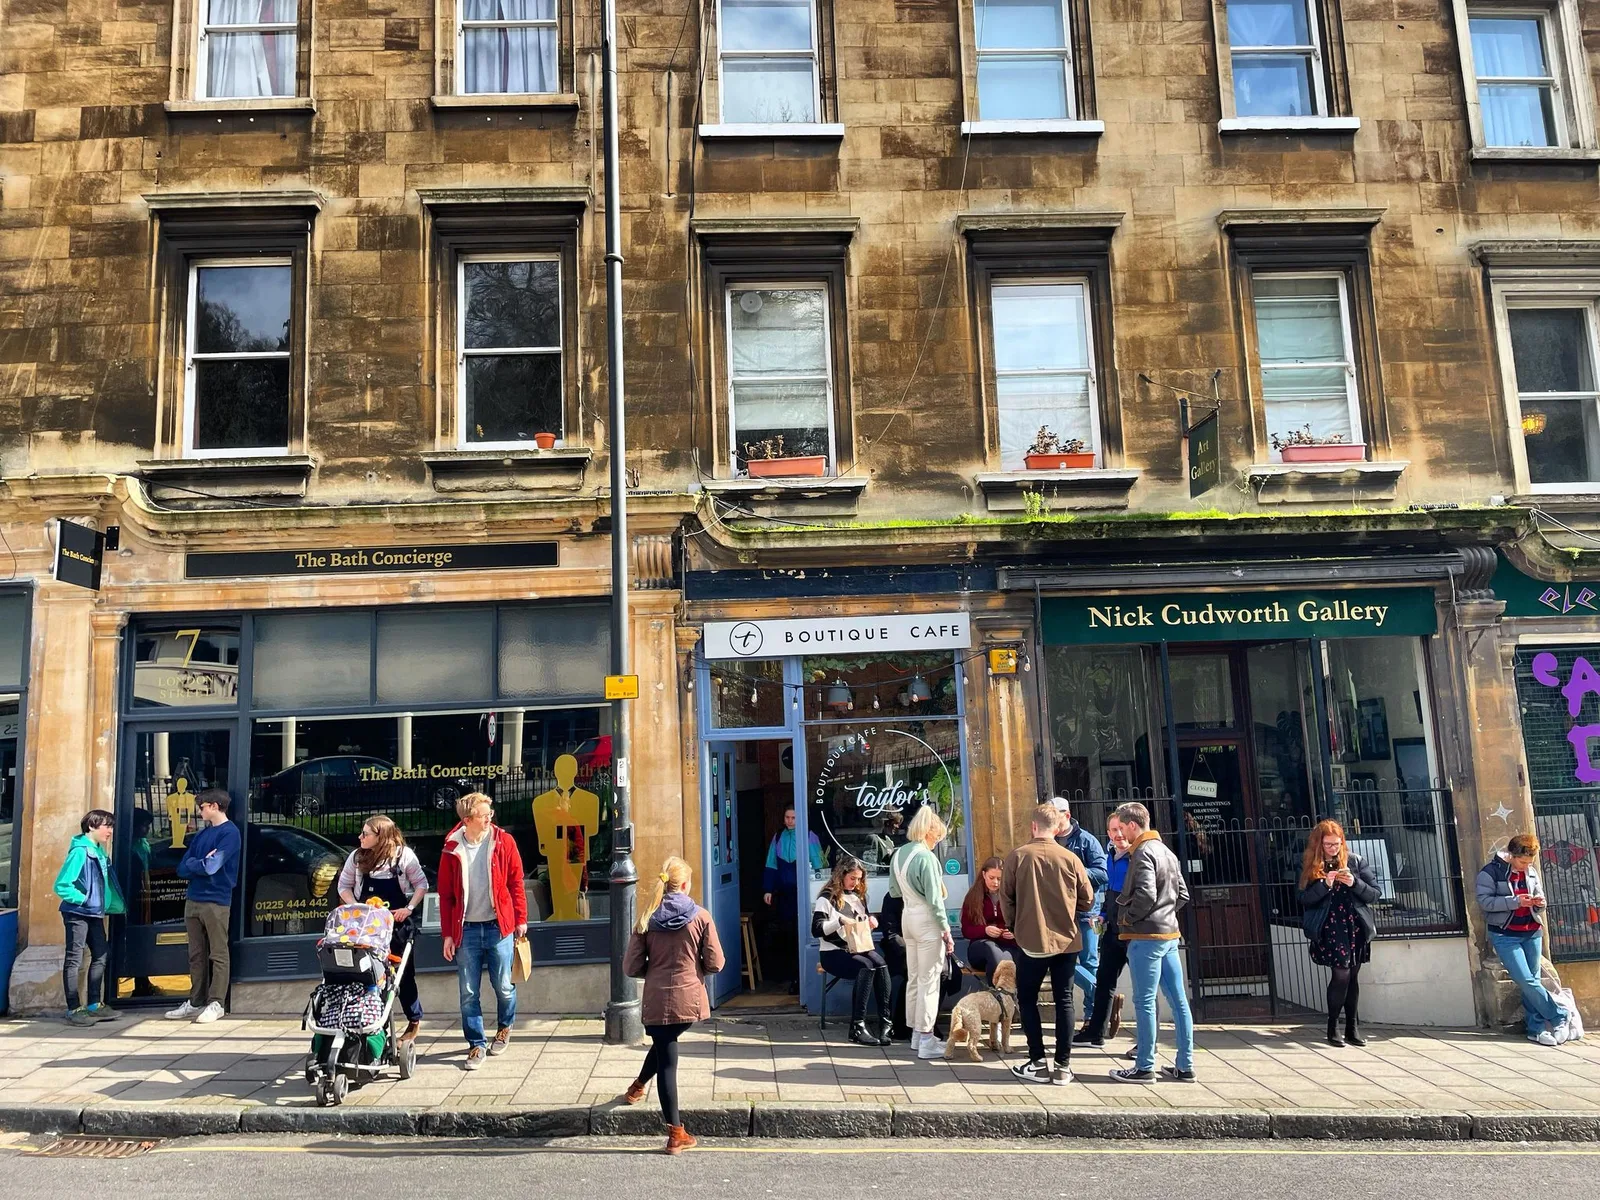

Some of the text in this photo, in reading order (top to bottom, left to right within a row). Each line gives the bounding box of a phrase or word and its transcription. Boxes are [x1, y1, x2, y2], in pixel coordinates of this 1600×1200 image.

[1197, 439, 1209, 456] Art
[1190, 459, 1217, 480] Gallery
[61, 547, 70, 558] The
[70, 550, 80, 561] Bath
[295, 549, 453, 568] The Bath Concierge
[1087, 600, 1389, 628] Nick Cudworth Gallery
[784, 627, 889, 643] BOUTIQUE
[910, 624, 961, 638] CAFE
[174, 628, 202, 669] 7
[158, 675, 214, 687] LONDON
[159, 687, 211, 699] STREET
[359, 762, 504, 781] The Bath Concierge
[815, 726, 878, 804] BOUTIQUE CAFE
[1190, 784, 1215, 792] CLOSED
[844, 779, 930, 818] taylor's
[255, 898, 328, 910] 01225 444 442
